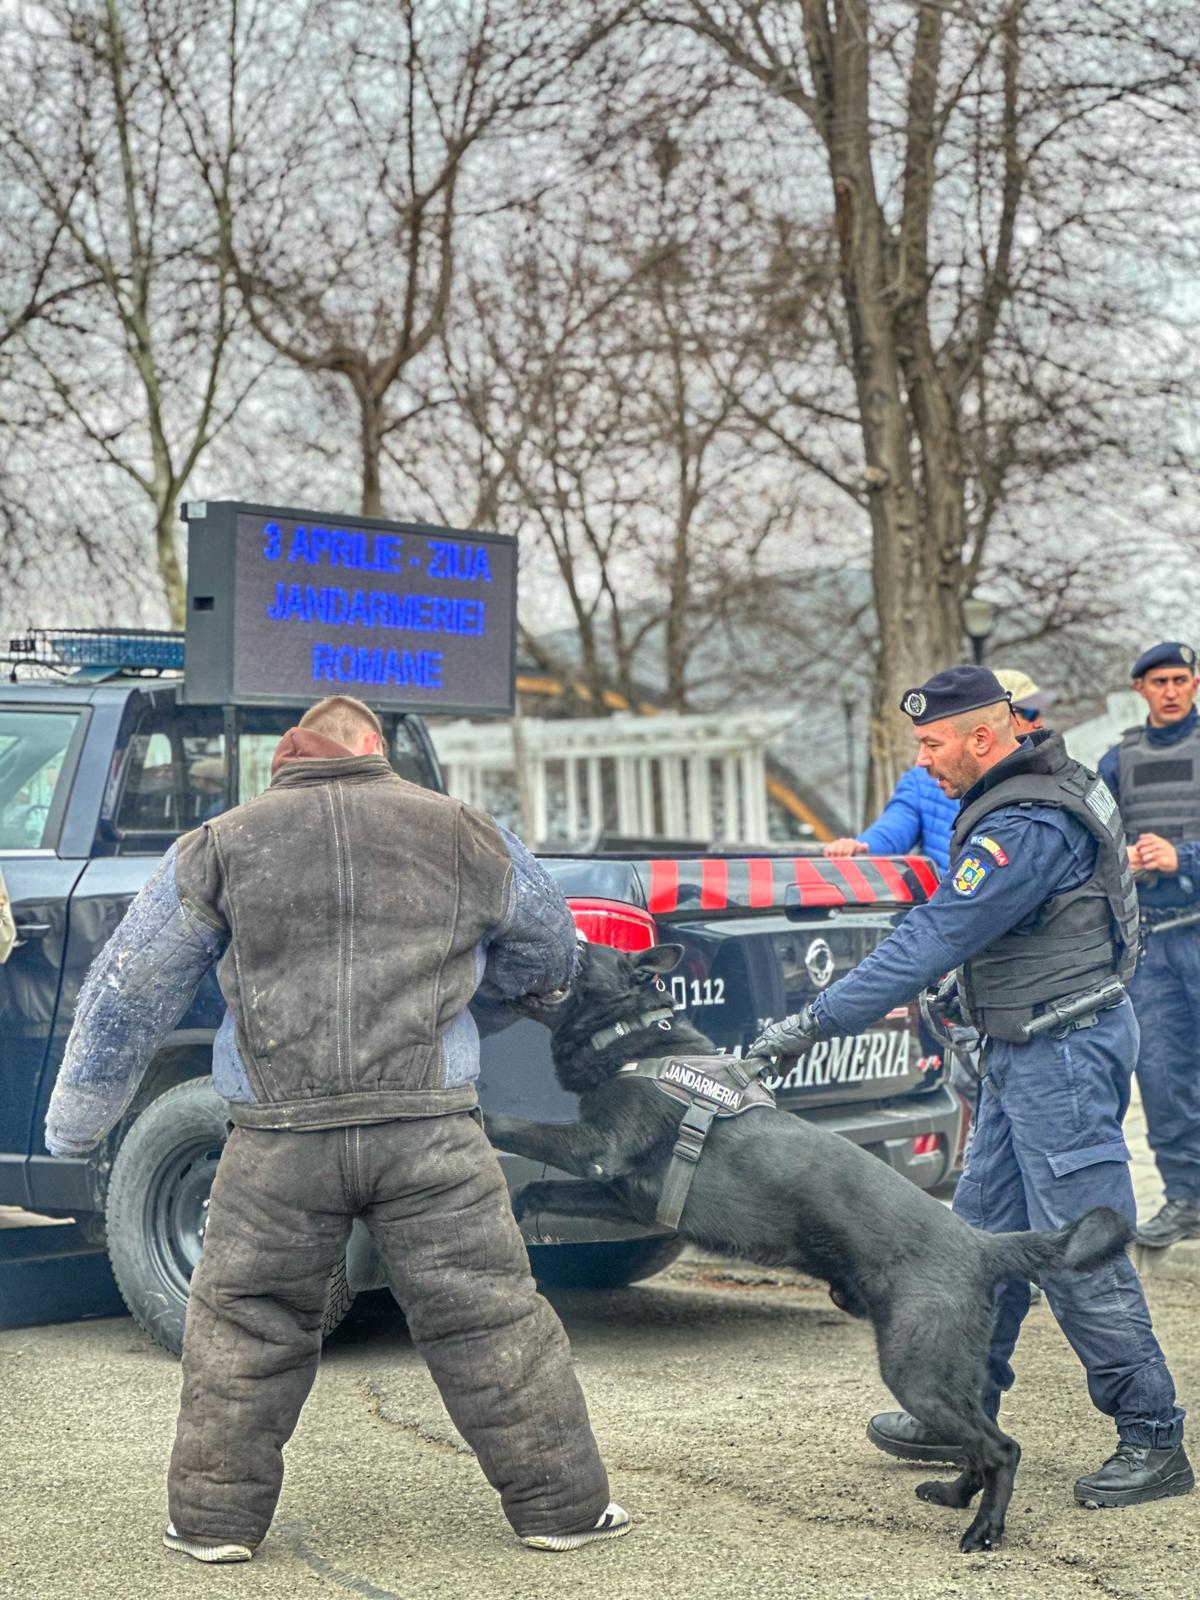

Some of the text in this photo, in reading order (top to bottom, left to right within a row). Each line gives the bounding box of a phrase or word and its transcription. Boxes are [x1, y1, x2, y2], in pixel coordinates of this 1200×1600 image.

[264, 522, 281, 561] 3
[288, 527, 403, 574] APRILIE
[427, 541, 492, 582] ZIUA
[267, 582, 485, 636] JANDARMERIEI
[313, 643, 443, 688] ROMANE
[690, 978, 725, 1006] 112
[665, 1064, 740, 1109] JANDARMERIA
